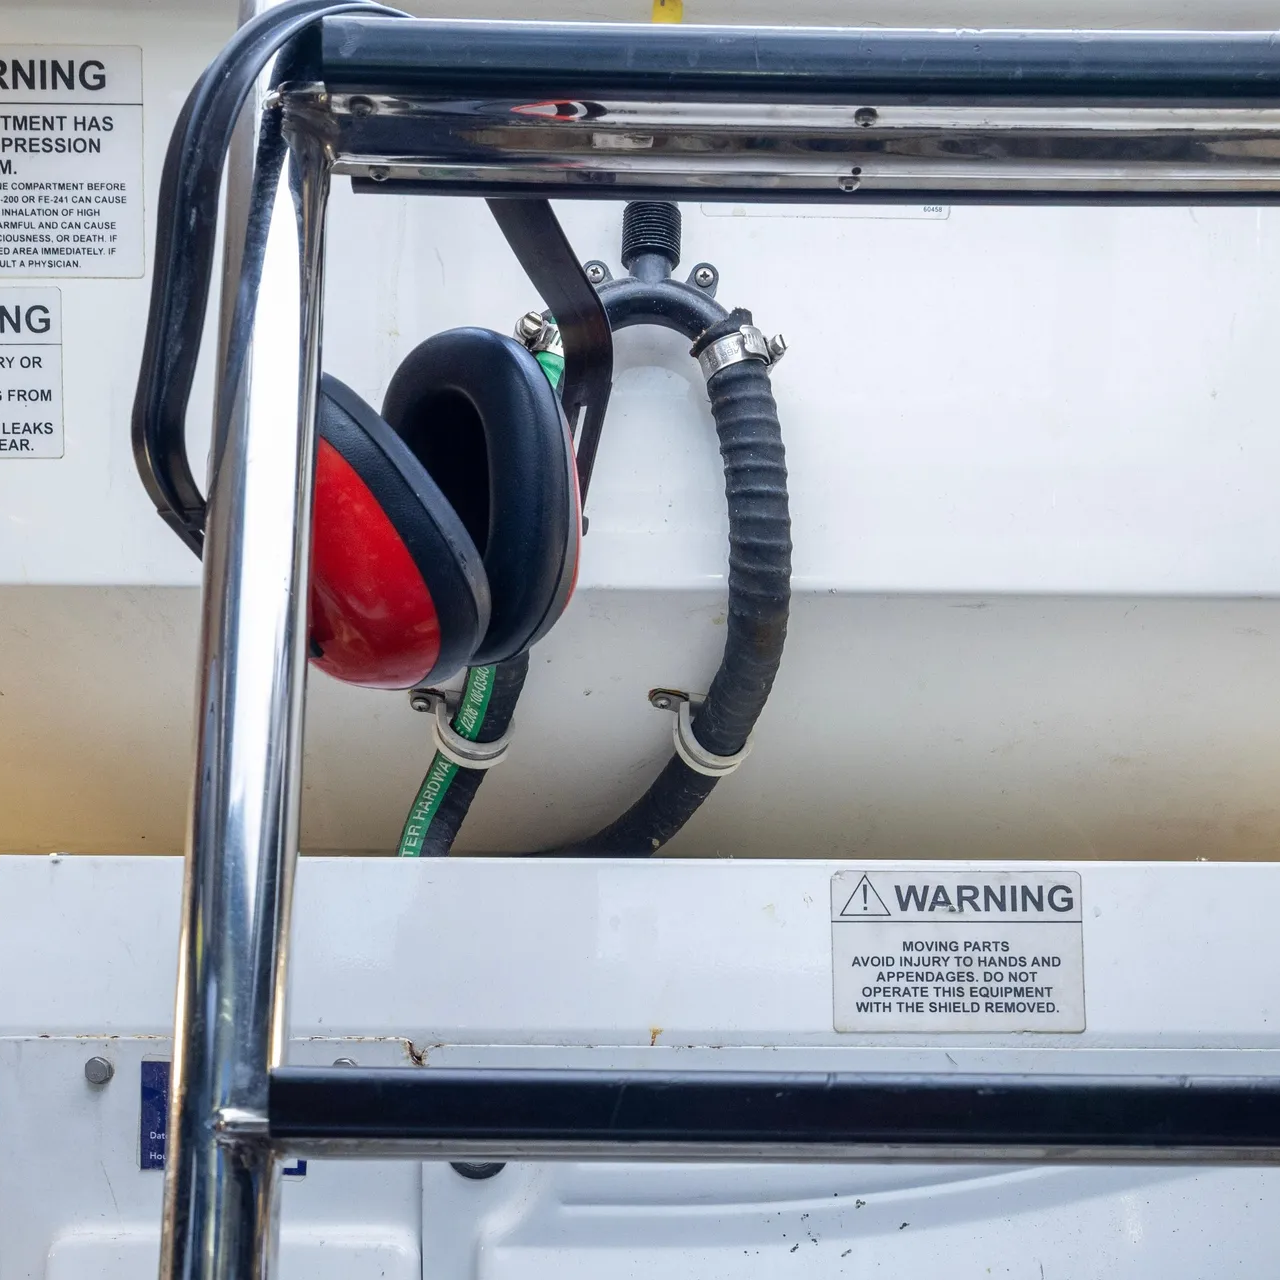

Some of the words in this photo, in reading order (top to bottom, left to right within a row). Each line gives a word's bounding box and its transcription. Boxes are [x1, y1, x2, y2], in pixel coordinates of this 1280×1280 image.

[74, 116, 113, 131] HAS
[28, 260, 81, 268] PHYSICIAN.
[20, 356, 42, 368] OR
[8, 390, 51, 401] FROM
[3, 422, 53, 434] LEAKS
[894, 885, 1073, 912] WARNING
[903, 941, 958, 952] MOVING
[964, 941, 1009, 952] PARTS
[852, 956, 894, 966] AVOID
[900, 956, 950, 967] INJURY
[954, 956, 973, 967] TO
[978, 956, 1027, 967] HANDS
[1031, 957, 1060, 967] AND
[876, 972, 978, 982] APPENDAGES.
[984, 972, 1004, 982] DO
[1009, 972, 1037, 982] NOT
[862, 987, 928, 997] OPERATE
[933, 987, 964, 997] THIS
[970, 987, 1053, 998] EQUIPMENT
[856, 1002, 891, 1012] WITH
[896, 1002, 924, 1012] THE
[929, 1002, 980, 1012] SHIELD
[985, 1002, 1059, 1012] REMOVED.
